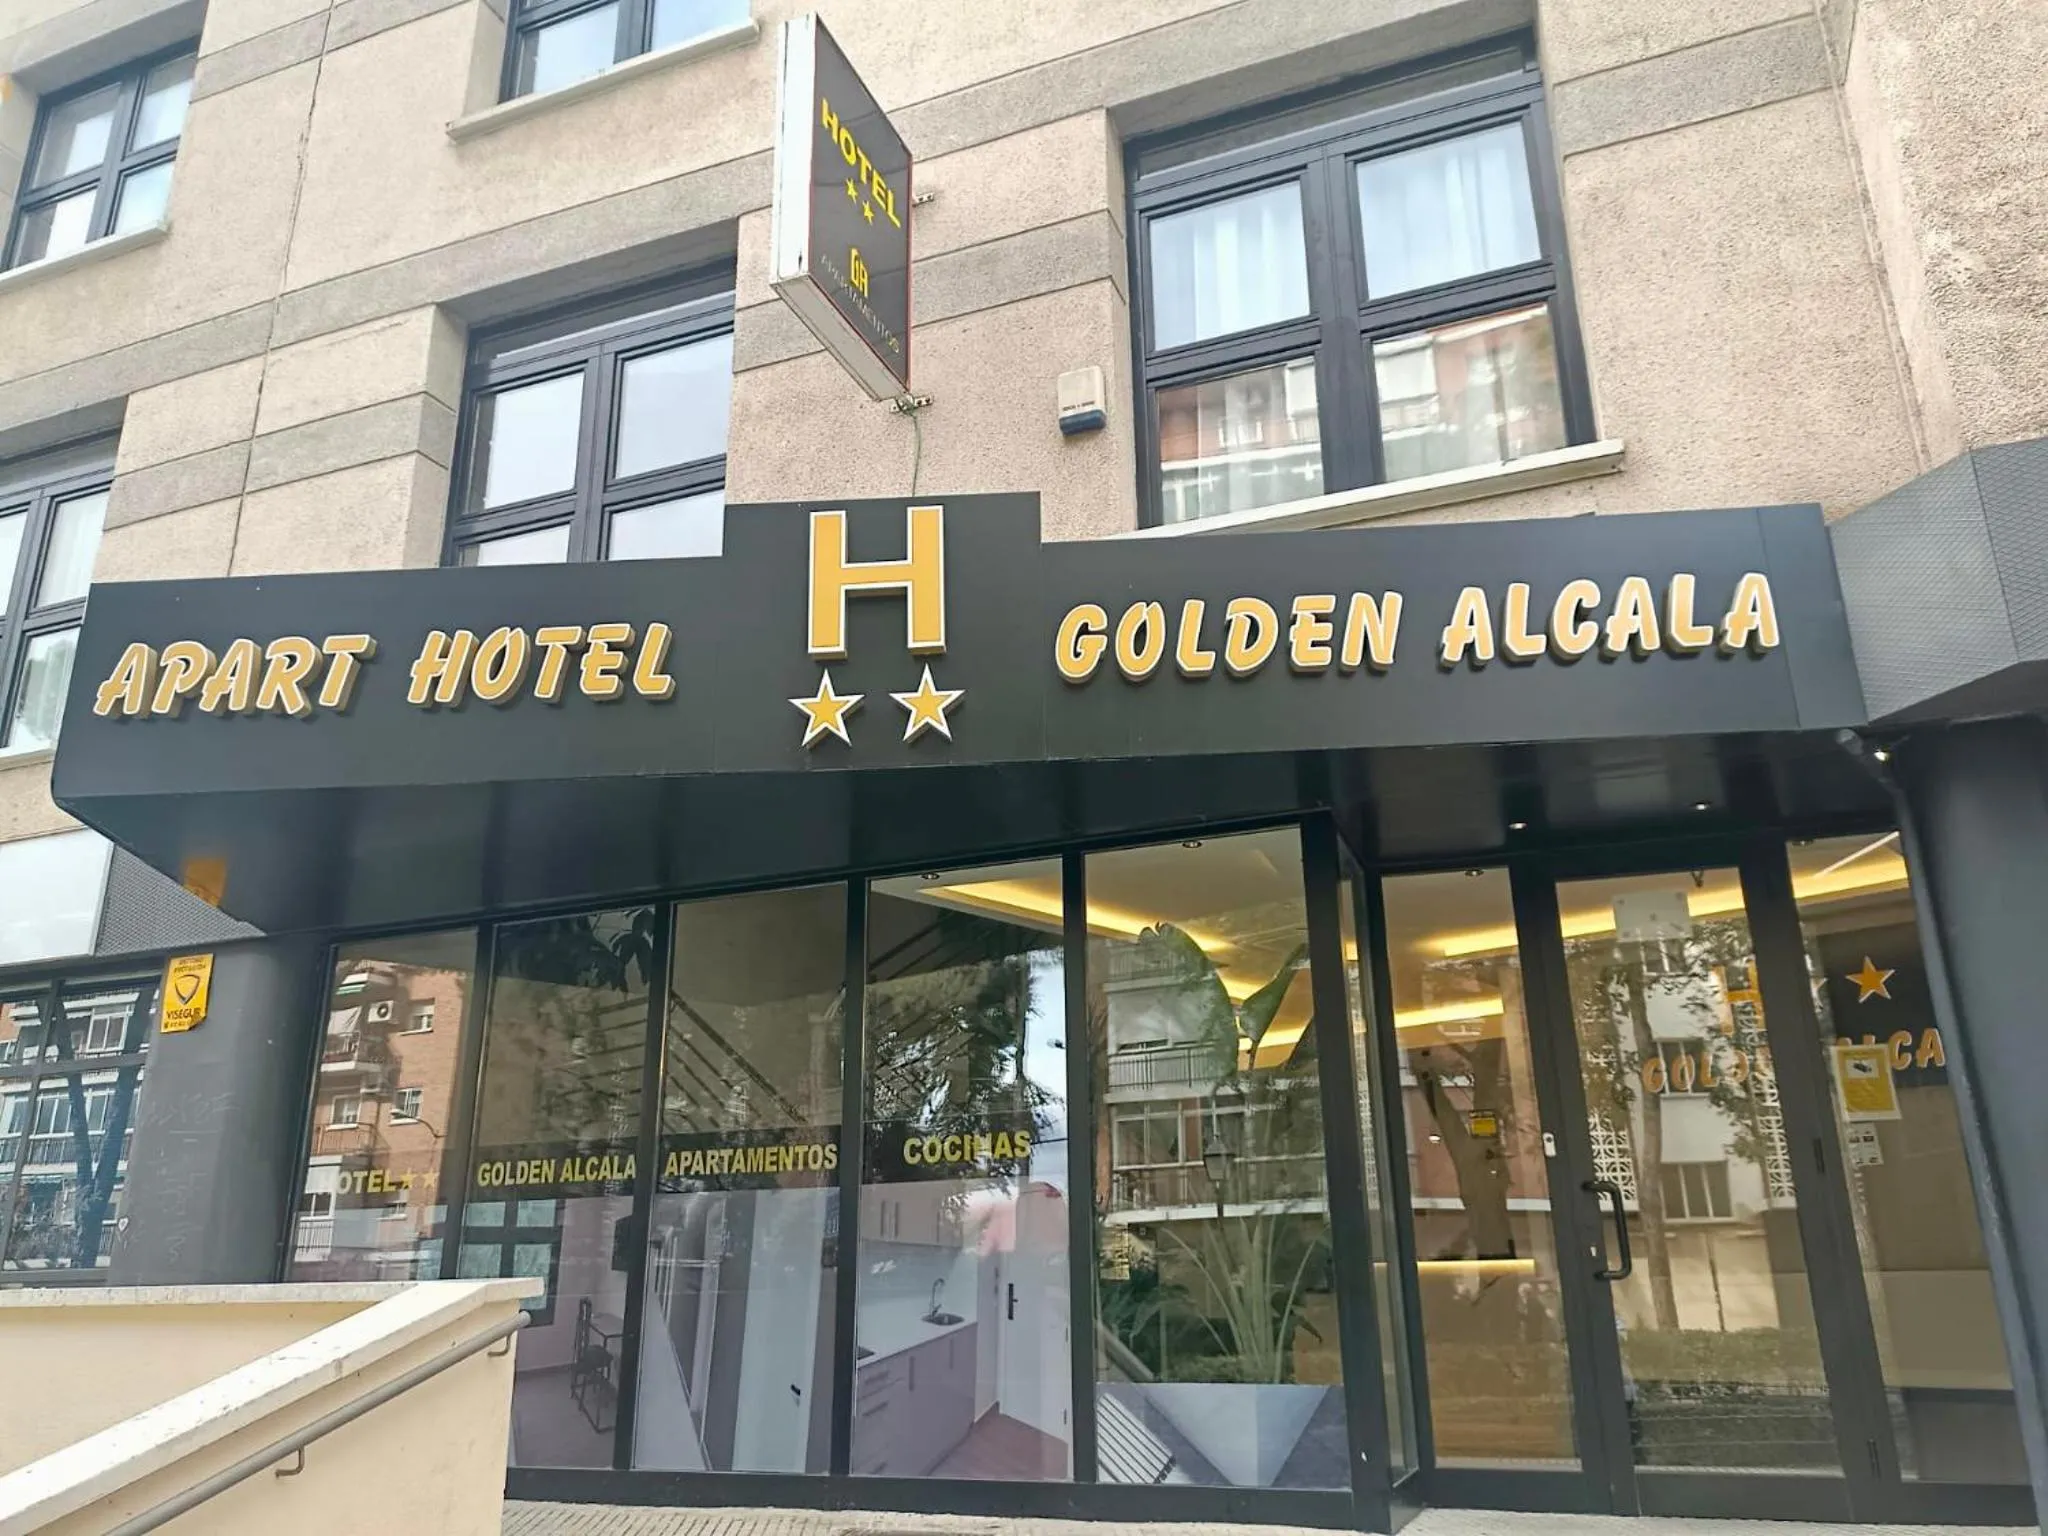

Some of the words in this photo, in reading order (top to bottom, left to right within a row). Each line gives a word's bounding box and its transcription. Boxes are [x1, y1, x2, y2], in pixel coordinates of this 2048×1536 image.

[822, 98, 900, 228] HOTEL
[808, 505, 946, 660] H
[1055, 591, 1403, 684] GOLDEN
[1440, 572, 1780, 667] ALCALA
[93, 634, 377, 718] APART
[407, 622, 677, 706] HOTEL
[477, 1159, 556, 1187] GOLDEN
[559, 1154, 637, 1183] ALCALA
[664, 1143, 838, 1177] APARTAMENTOS
[903, 1130, 1032, 1165] COCINAS
